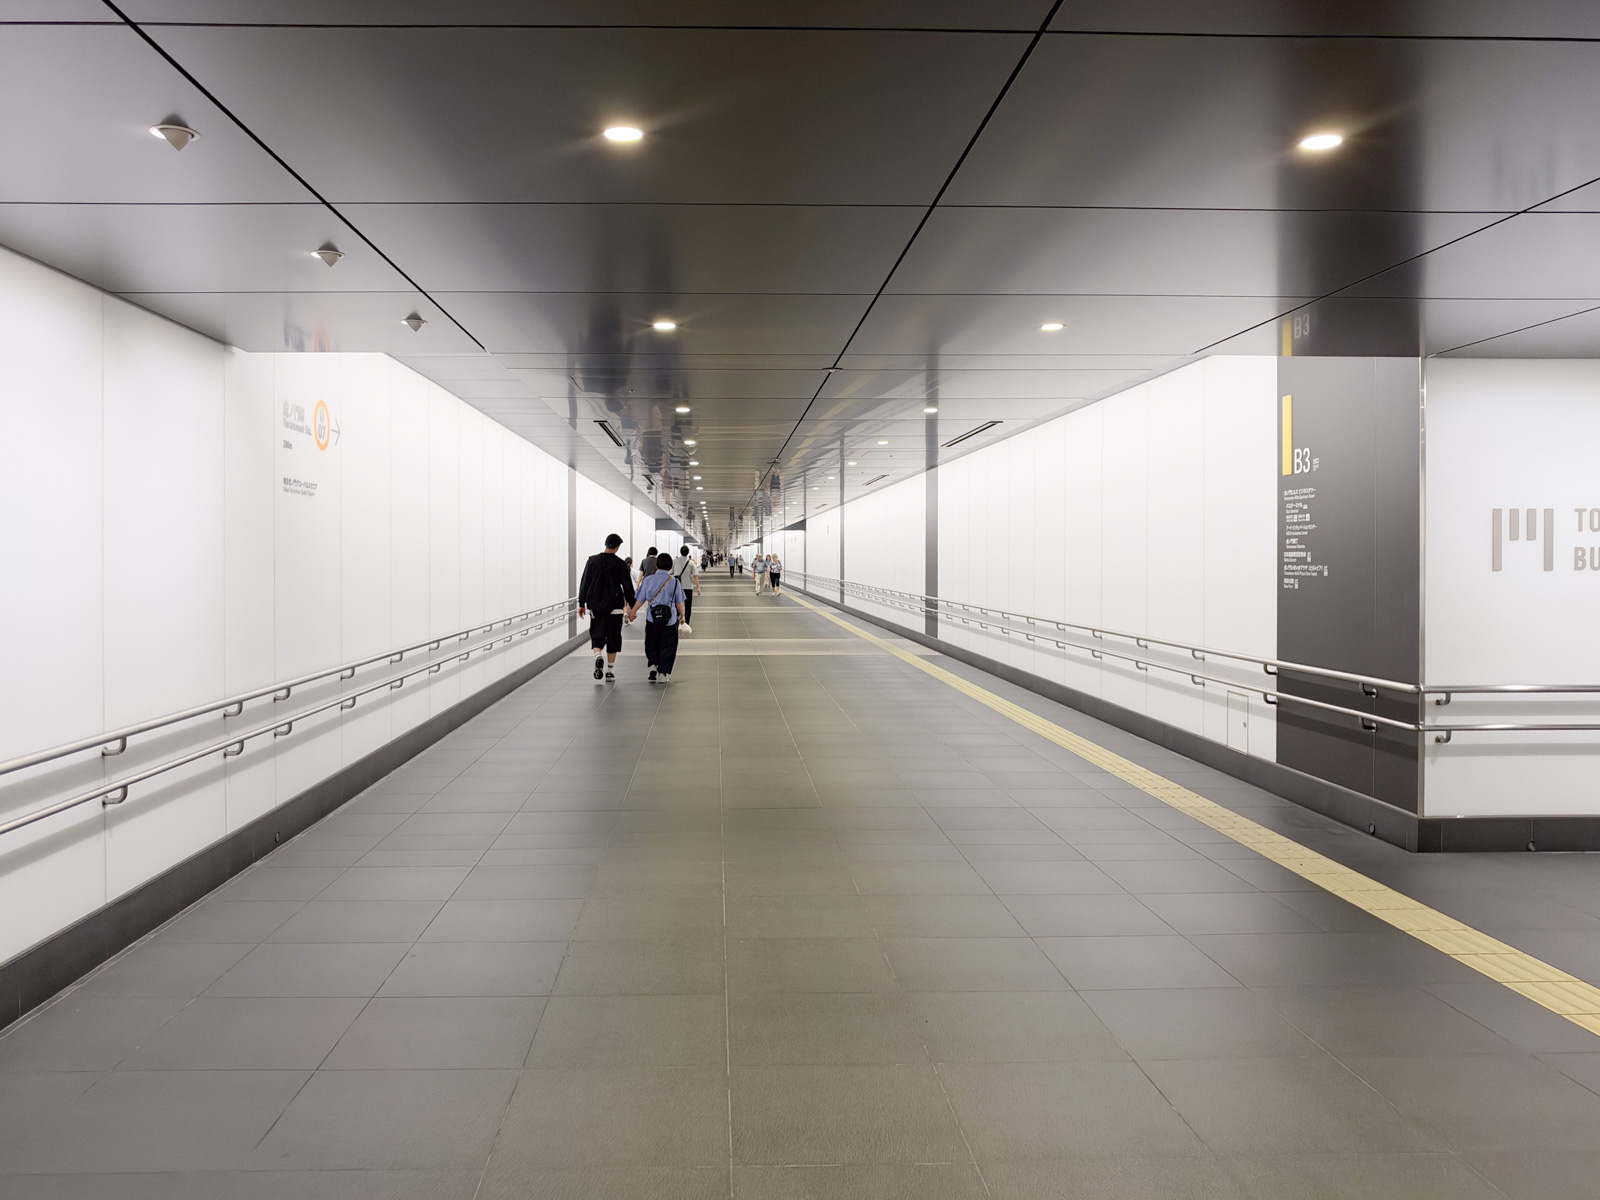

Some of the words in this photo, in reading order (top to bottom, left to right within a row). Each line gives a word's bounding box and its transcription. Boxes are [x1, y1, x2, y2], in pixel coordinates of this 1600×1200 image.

[318, 424, 326, 439] 07
[1294, 447, 1310, 474] B3
[1574, 508, 1600, 532] TO
[1574, 547, 1600, 571] BU
